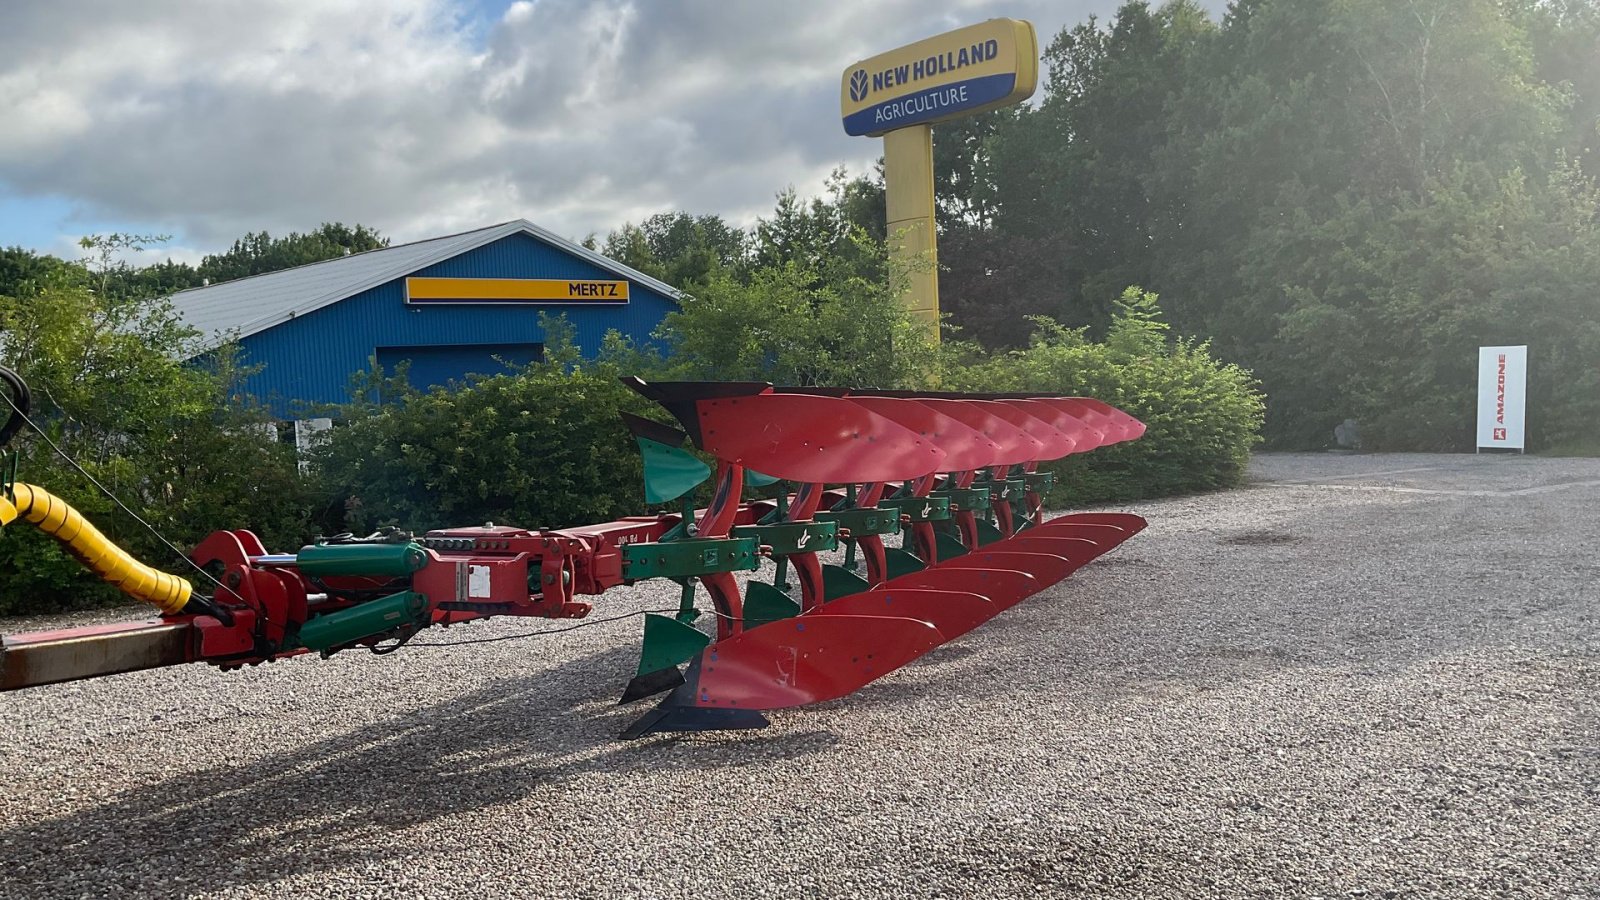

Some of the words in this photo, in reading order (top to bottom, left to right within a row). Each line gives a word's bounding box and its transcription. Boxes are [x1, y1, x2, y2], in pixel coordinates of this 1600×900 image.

[872, 64, 910, 92] NEW
[913, 39, 998, 81] HOLLAND
[875, 85, 968, 124] AGRICULTURE
[569, 283, 618, 297] MERTZ
[1497, 354, 1506, 424] AMAZONE
